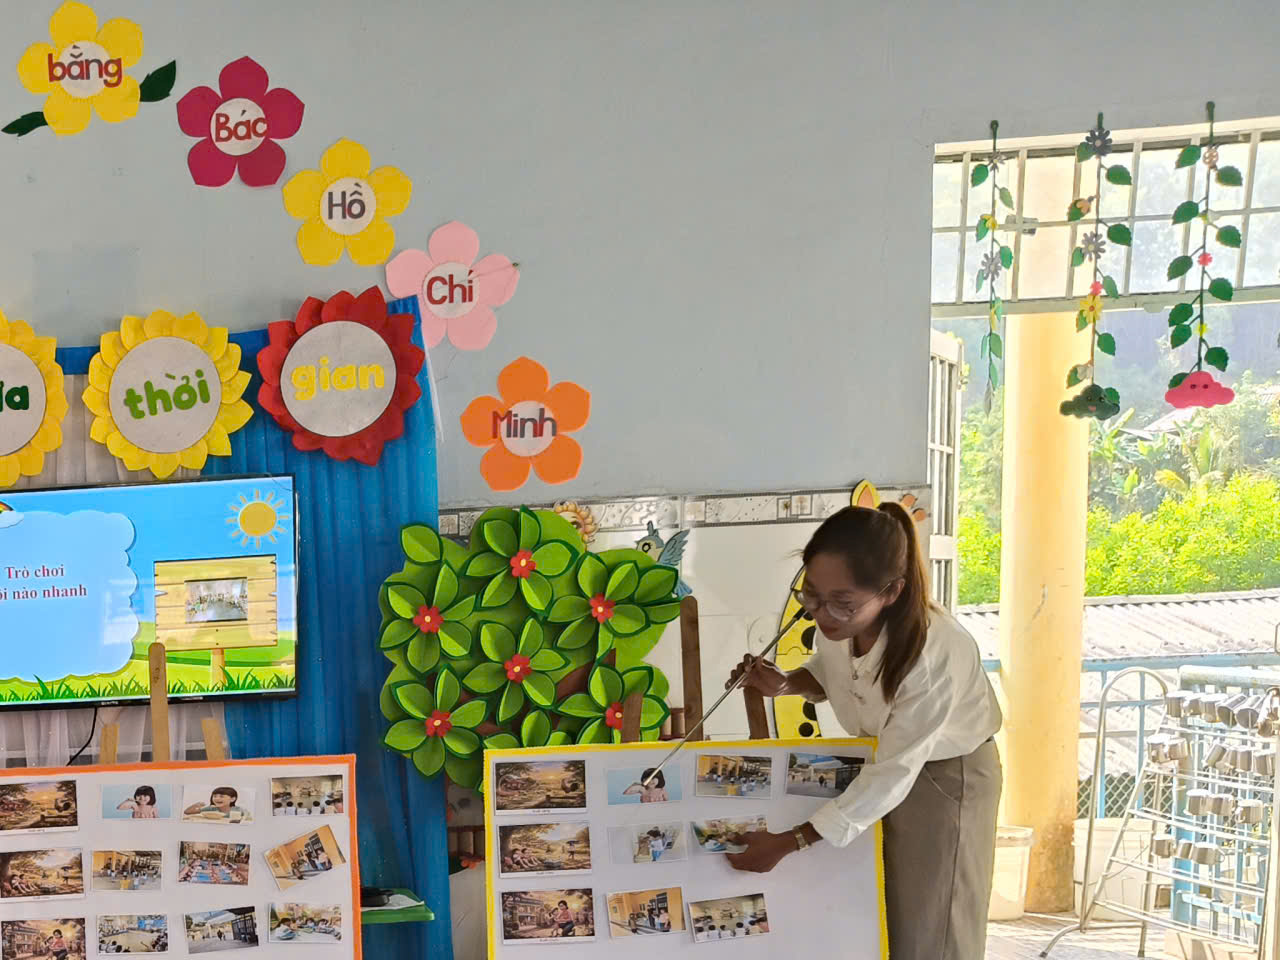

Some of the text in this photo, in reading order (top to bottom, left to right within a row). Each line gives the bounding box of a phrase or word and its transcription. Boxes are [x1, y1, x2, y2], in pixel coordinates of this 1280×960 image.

[48, 44, 123, 88] bằng
[215, 109, 268, 143] Bác
[327, 182, 367, 220] Hồ
[426, 269, 475, 305] Chí
[491, 407, 557, 439] Minh
[123, 369, 211, 419] thời
[290, 355, 385, 400] gian
[5, 564, 64, 580] Trò chơi
[13, 585, 38, 600] nào
[42, 583, 87, 599] nhanh
